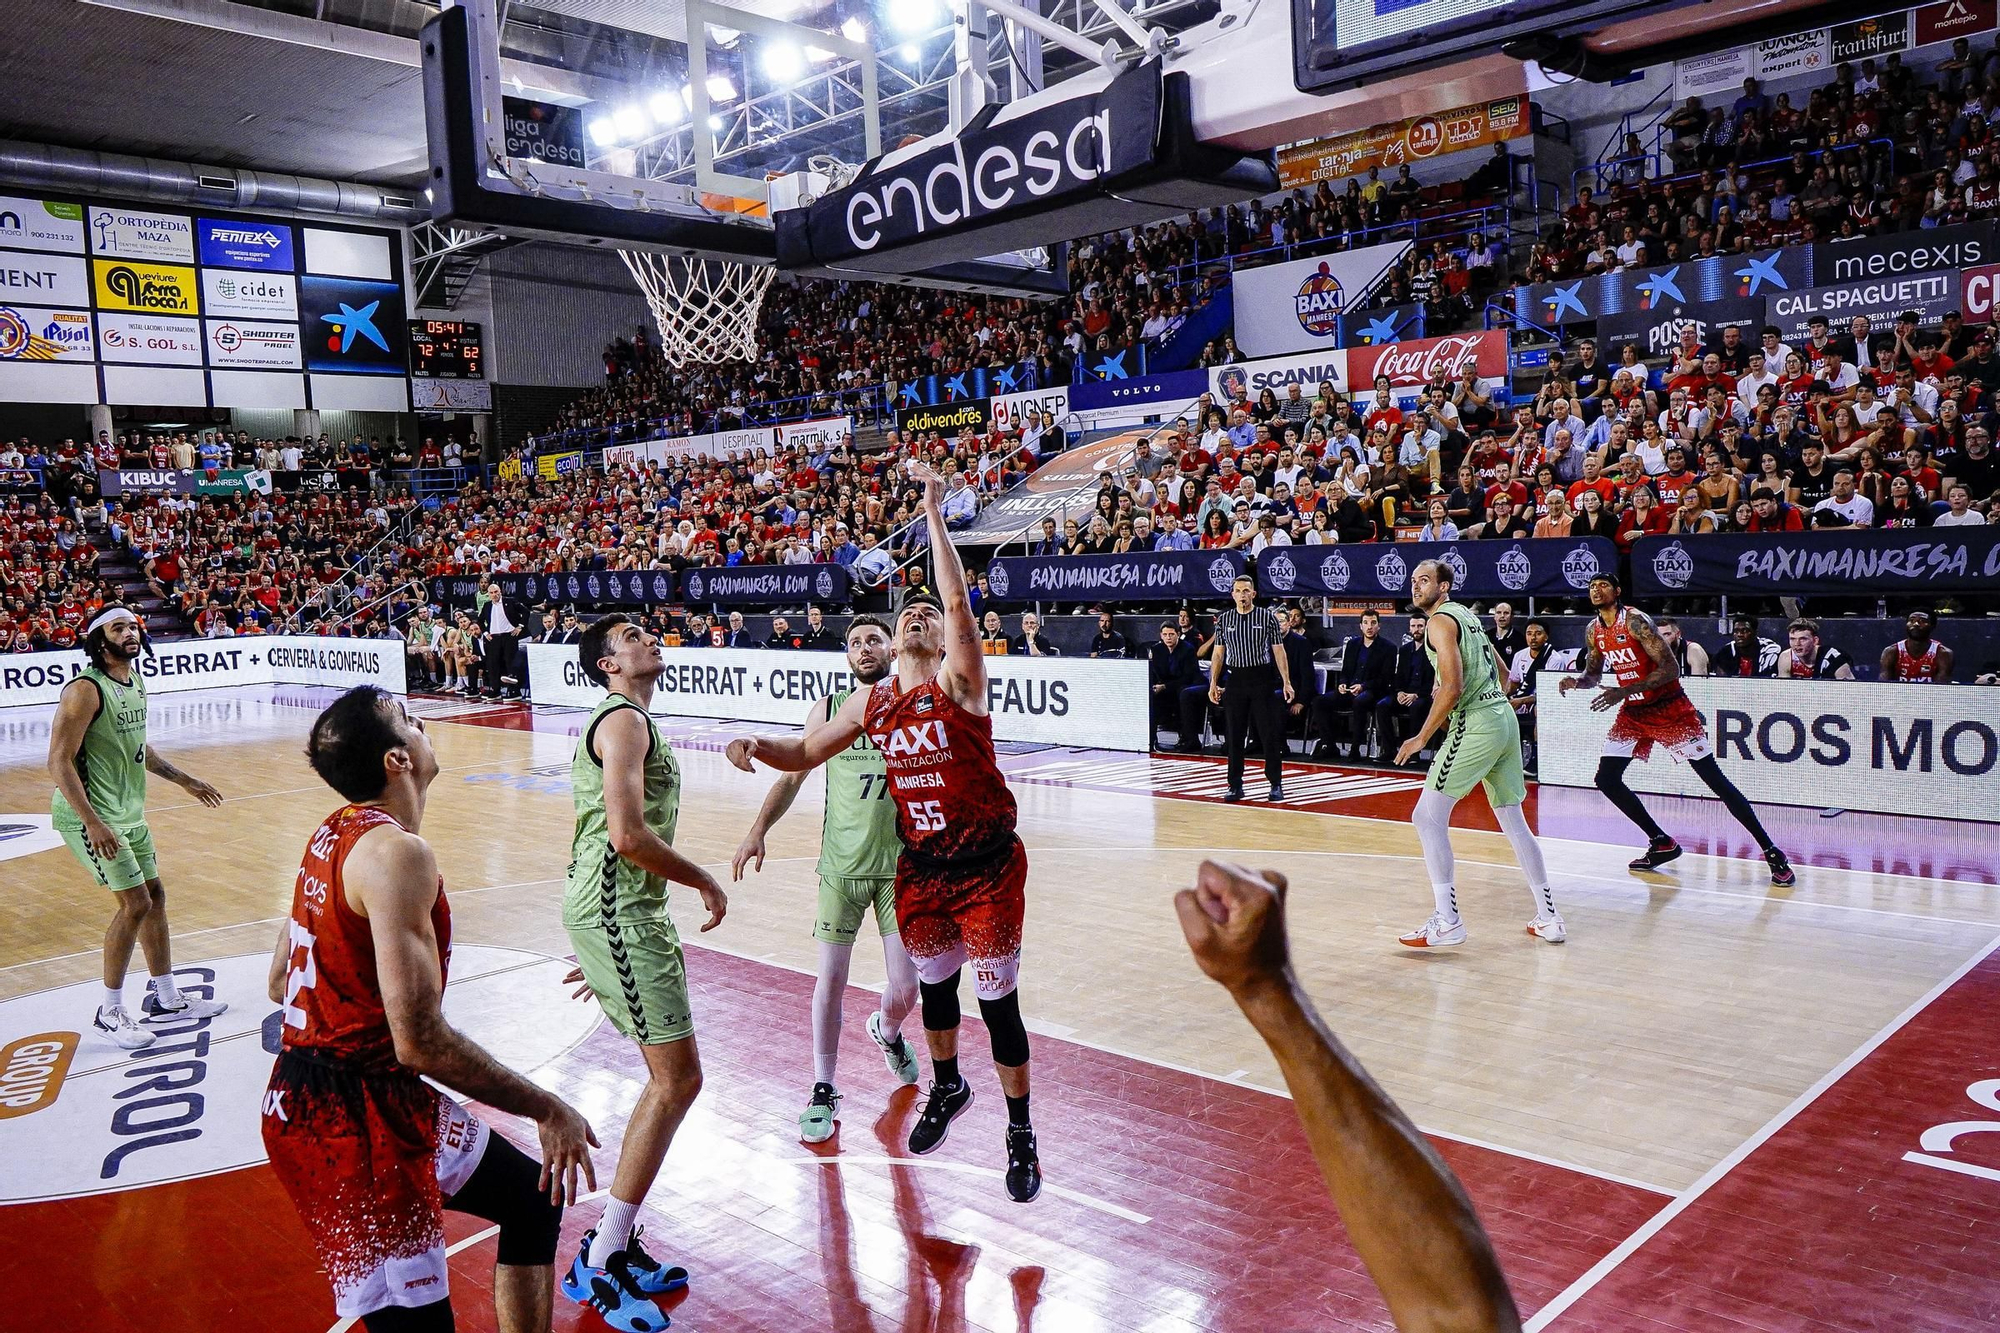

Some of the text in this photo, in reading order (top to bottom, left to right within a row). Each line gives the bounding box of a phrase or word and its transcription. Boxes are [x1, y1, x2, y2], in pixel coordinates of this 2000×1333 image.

[1935, 14, 1977, 29] montepio
[1759, 29, 1824, 52] JUANOLA
[1832, 27, 1907, 61] frankfurt
[1762, 59, 1801, 73] expert
[505, 114, 530, 137] liga
[1447, 116, 1482, 138] TDT
[1508, 115, 1519, 124] FM
[507, 138, 581, 162] endesa
[1413, 138, 1438, 149] taronja
[847, 108, 1113, 249] endesa
[1312, 163, 1352, 180] DIGITAL
[118, 216, 188, 232] ORTOPÈDIA
[137, 231, 171, 242] MAZA
[211, 229, 263, 244] PENTEX
[241, 282, 284, 297] cidet
[1776, 276, 1948, 316] CAL SPAGUETTI
[1967, 275, 2000, 314] C
[142, 296, 178, 309] roca
[1300, 289, 1343, 313] BAXI
[243, 330, 295, 339] SHOOTER
[428, 321, 462, 334] 05:41
[129, 337, 142, 348] S.
[147, 339, 177, 350] GOL
[1781, 331, 1802, 341] 08243
[419, 344, 433, 356] 72
[443, 342, 449, 350] 4
[464, 347, 479, 358] 62
[1373, 335, 1485, 382] Coca-Cola
[470, 363, 476, 371] 5
[1252, 364, 1339, 390] SCANIA
[431, 386, 457, 406] 20
[1112, 385, 1161, 397] VOLVO
[1011, 395, 1065, 420] AIGNEP
[1097, 410, 1119, 418] Premium
[907, 409, 982, 431] eldivendres
[667, 438, 690, 448] RAMON
[606, 447, 635, 465] Kadira
[120, 473, 176, 486] KIBUC
[199, 479, 243, 488] UMANRESA
[1270, 567, 1295, 577] BAXI
[1322, 566, 1349, 576] BAXI
[1378, 566, 1406, 576] BAXI
[1499, 562, 1530, 574] BAXI
[1564, 561, 1598, 573] BAXI
[1655, 559, 1691, 572] BAXI
[990, 575, 1009, 584] BAXI
[1030, 563, 1184, 590] BAXIMANRESA.COM
[1211, 569, 1235, 580] BAXI
[709, 575, 809, 595] BAXIMANRESA.COM
[0, 664, 65, 689] ROS
[268, 647, 317, 669] CERVERA
[319, 650, 327, 670] &
[328, 650, 380, 674] GONFAUS
[1698, 709, 1852, 766] ROS
[134, 743, 144, 763] 6
[859, 773, 888, 800] 77
[907, 800, 946, 832] 55
[977, 970, 999, 981] ETL
[979, 977, 1014, 991] GLOBAL
[0, 1041, 64, 1107] GROUP
[446, 1120, 466, 1150] ETL
